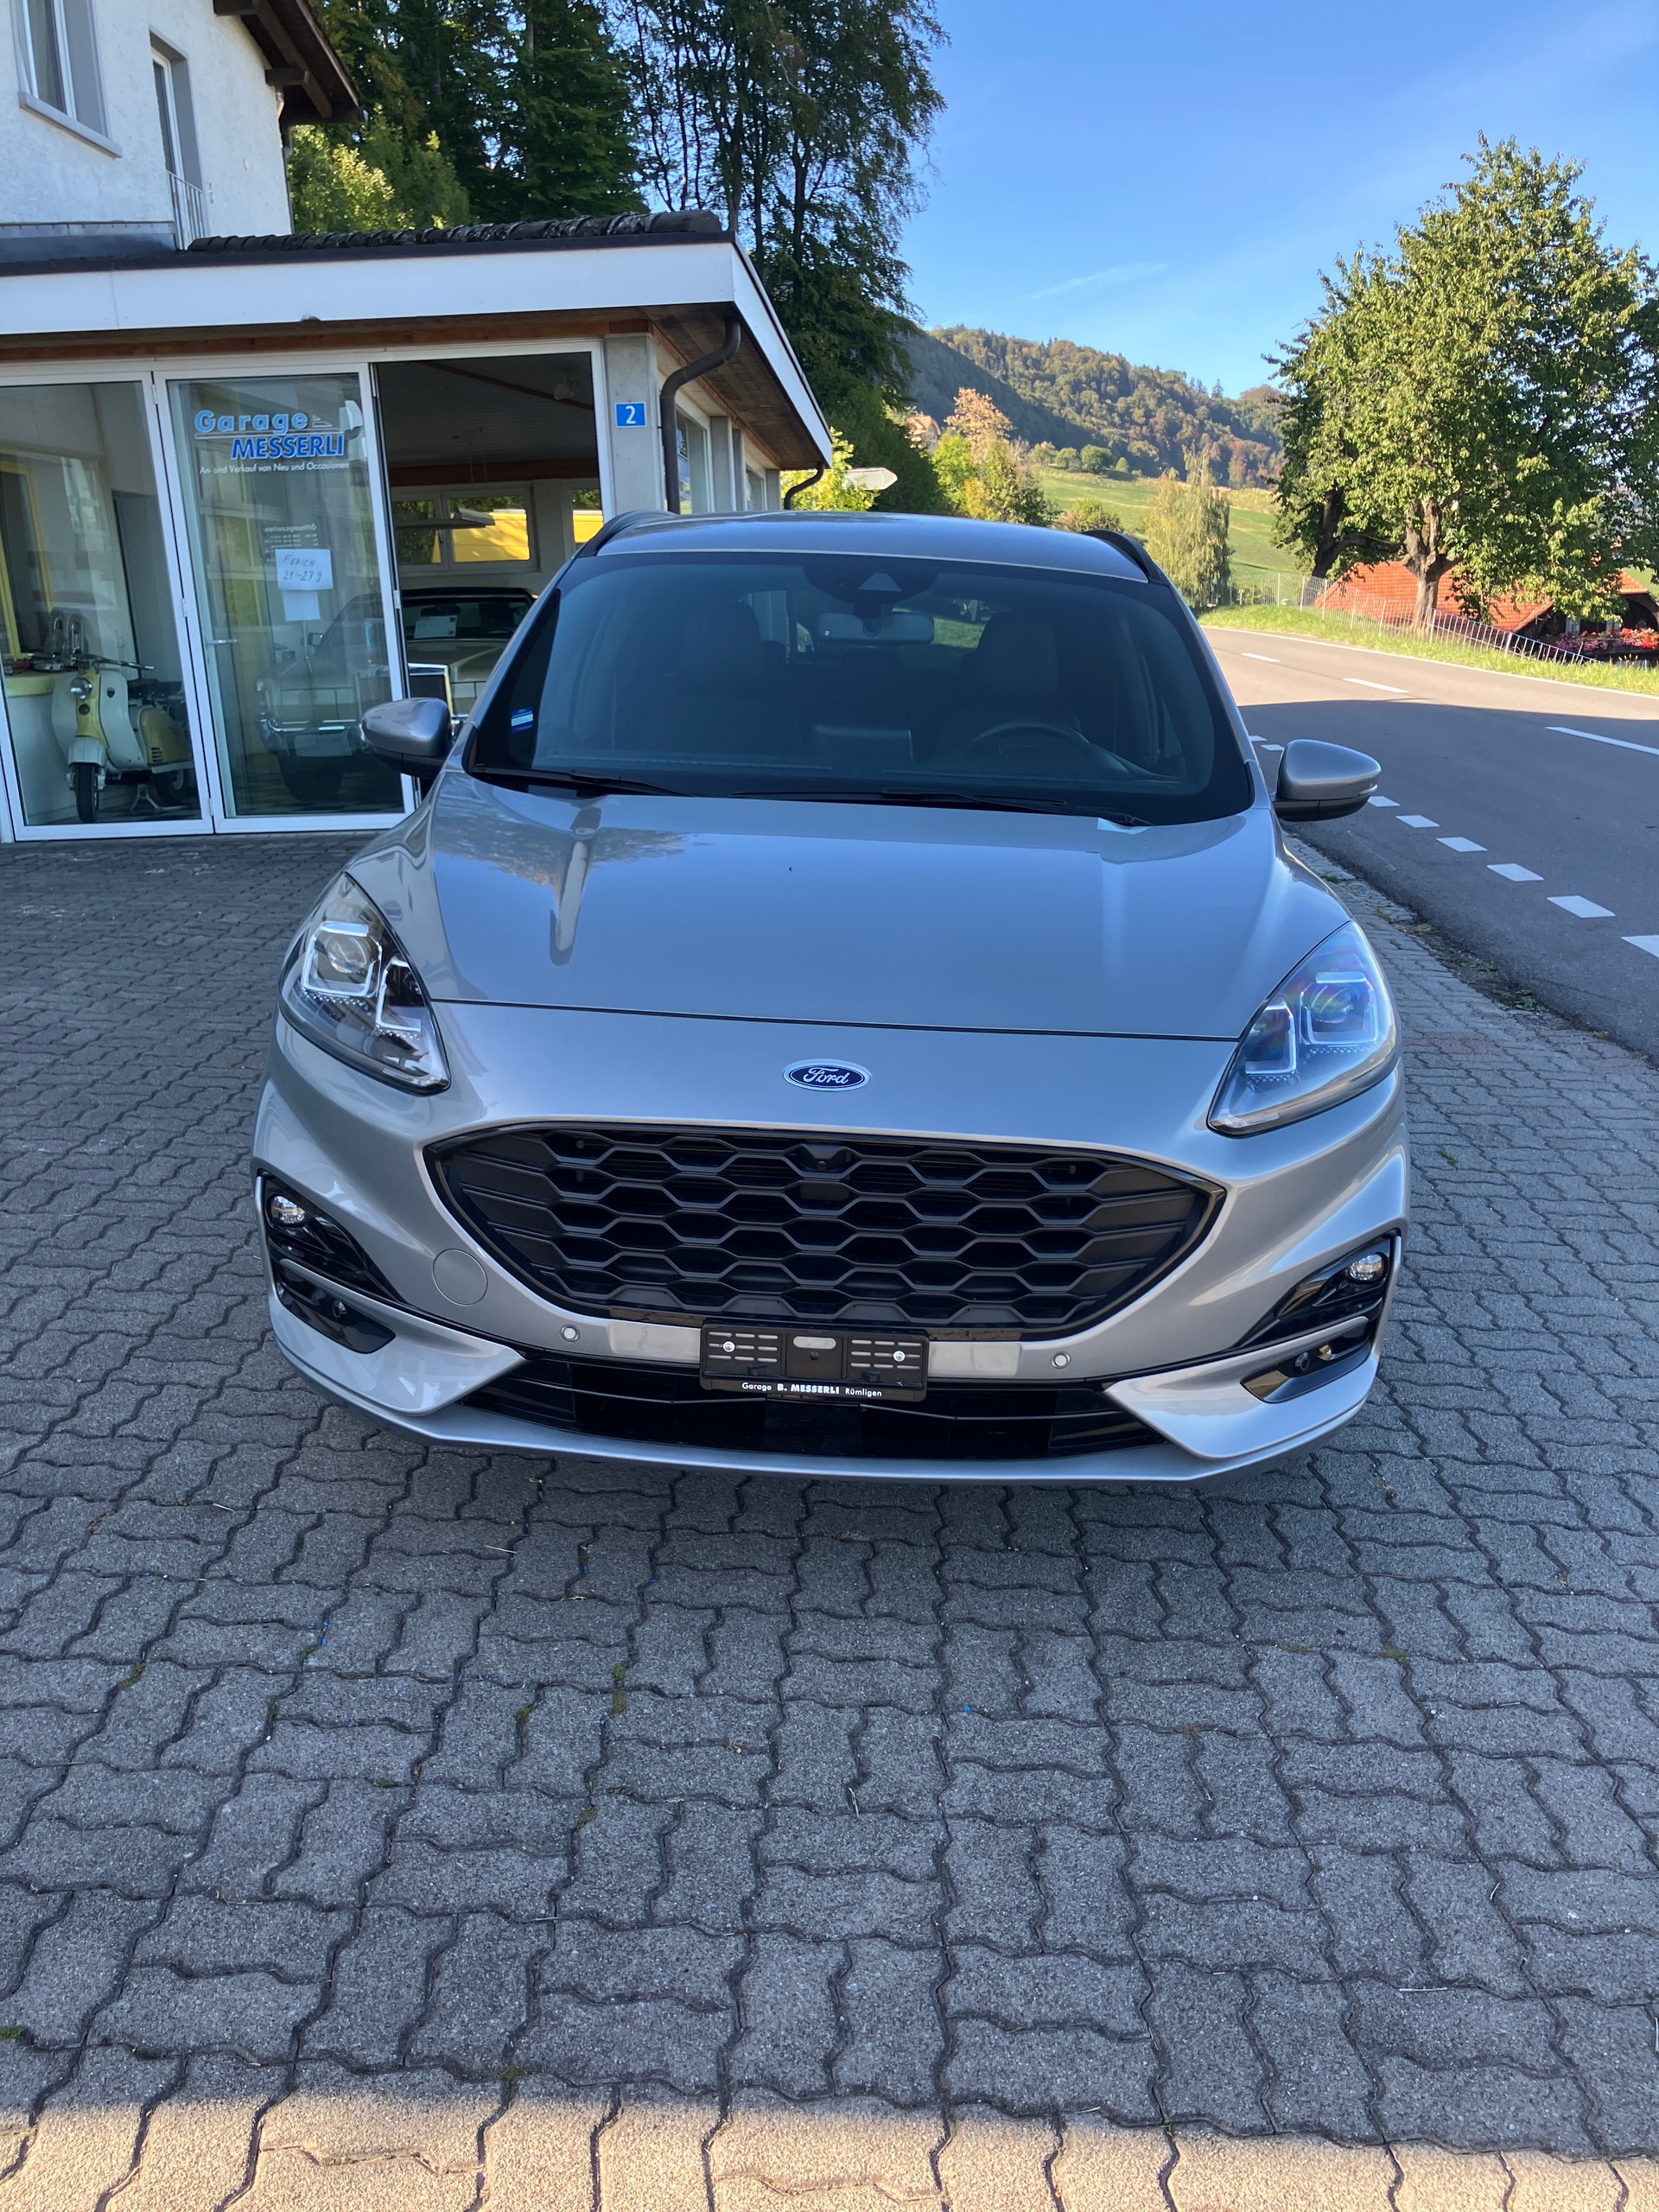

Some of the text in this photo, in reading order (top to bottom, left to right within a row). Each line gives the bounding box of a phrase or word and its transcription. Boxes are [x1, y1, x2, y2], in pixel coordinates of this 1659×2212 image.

[194, 410, 308, 435] Garage
[625, 404, 637, 424] 2
[231, 435, 345, 461] MESSERLI
[213, 465, 228, 474] und
[229, 462, 257, 474] Verkauf
[273, 462, 289, 472] Neu
[290, 461, 305, 471] und
[306, 461, 349, 470] Occasionen
[283, 554, 316, 567] FERIEN
[803, 1067, 850, 1084] Ford
[741, 1382, 772, 1392] Garage
[777, 1382, 788, 1392] B.
[790, 1383, 840, 1395] MESSERLI
